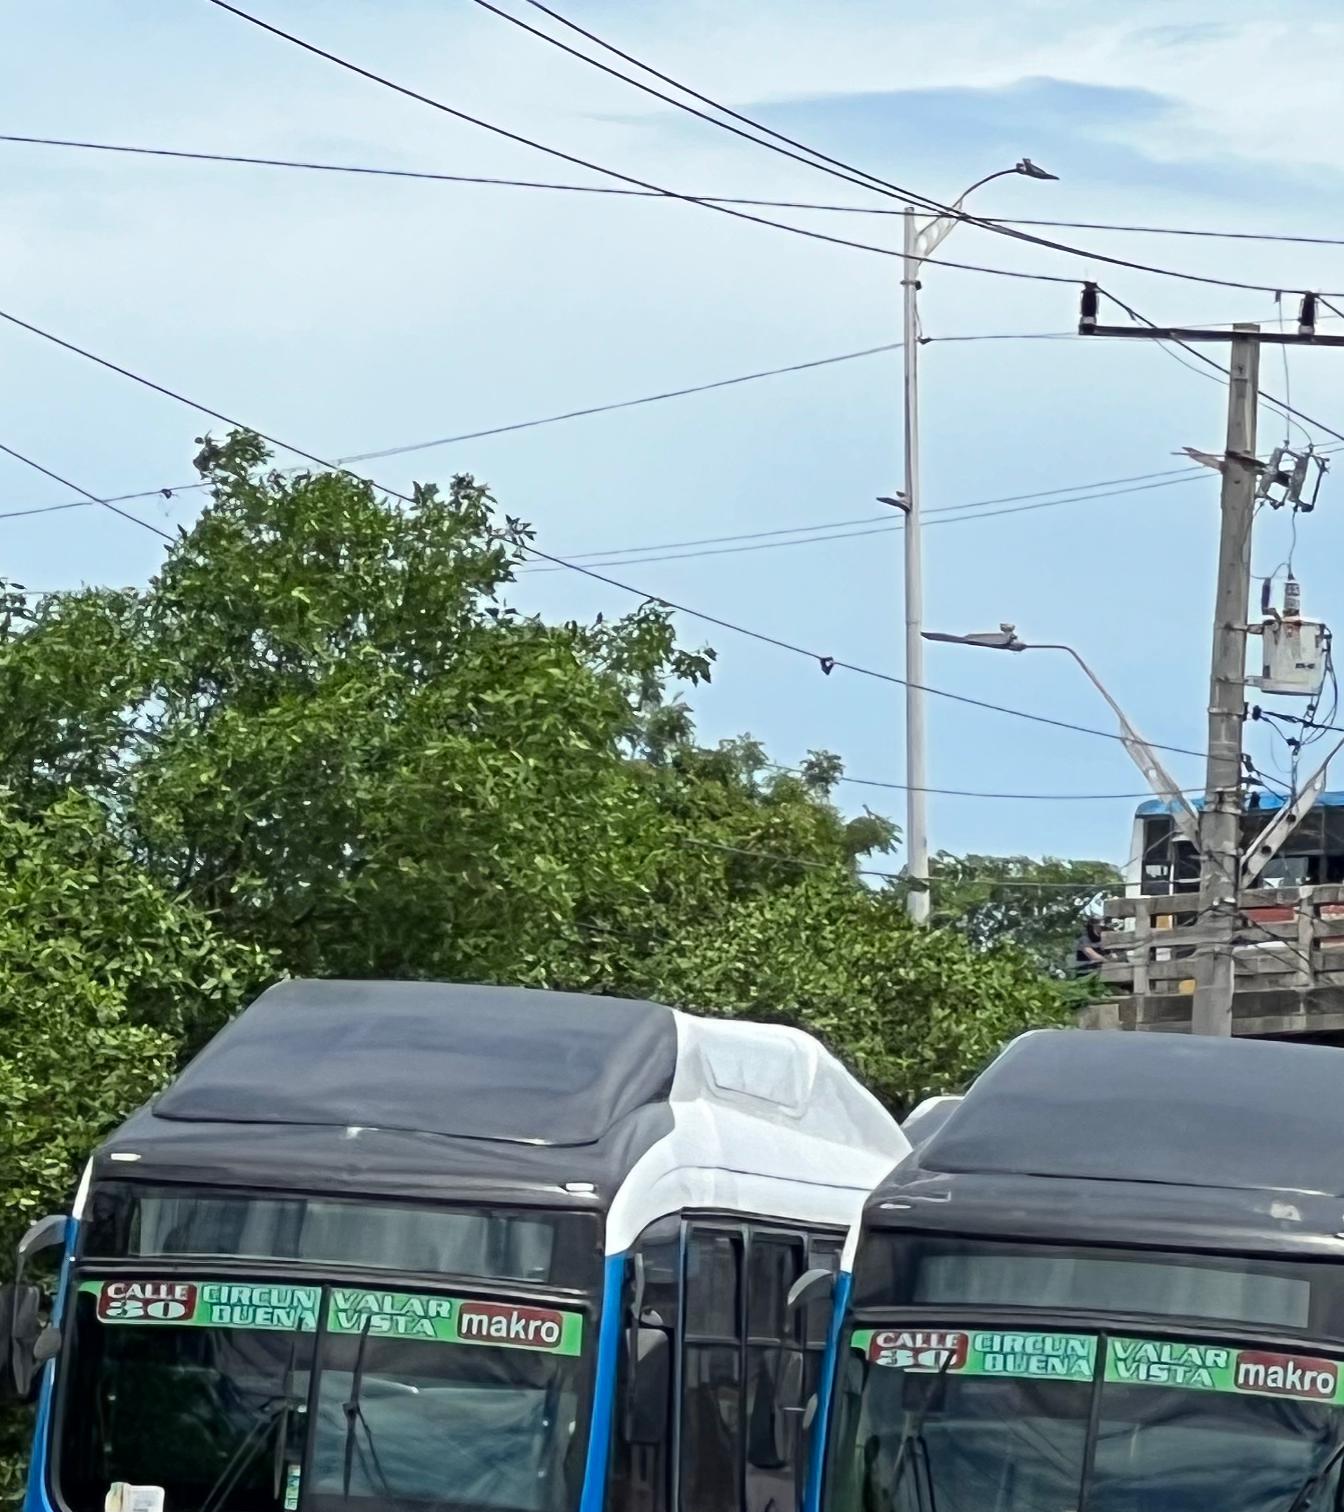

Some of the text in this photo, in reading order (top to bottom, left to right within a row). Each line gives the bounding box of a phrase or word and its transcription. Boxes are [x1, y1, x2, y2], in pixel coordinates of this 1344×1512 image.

[106, 1282, 188, 1300] CALLE
[202, 1285, 453, 1318] CIRCUN VALAR
[336, 1311, 437, 1337] VISTA
[460, 1311, 560, 1343] makro
[876, 1332, 958, 1349] CALLE
[974, 1333, 1229, 1368] CIRCUN VALAR
[1116, 1361, 1214, 1388] VISTA
[1238, 1361, 1336, 1395] makro
